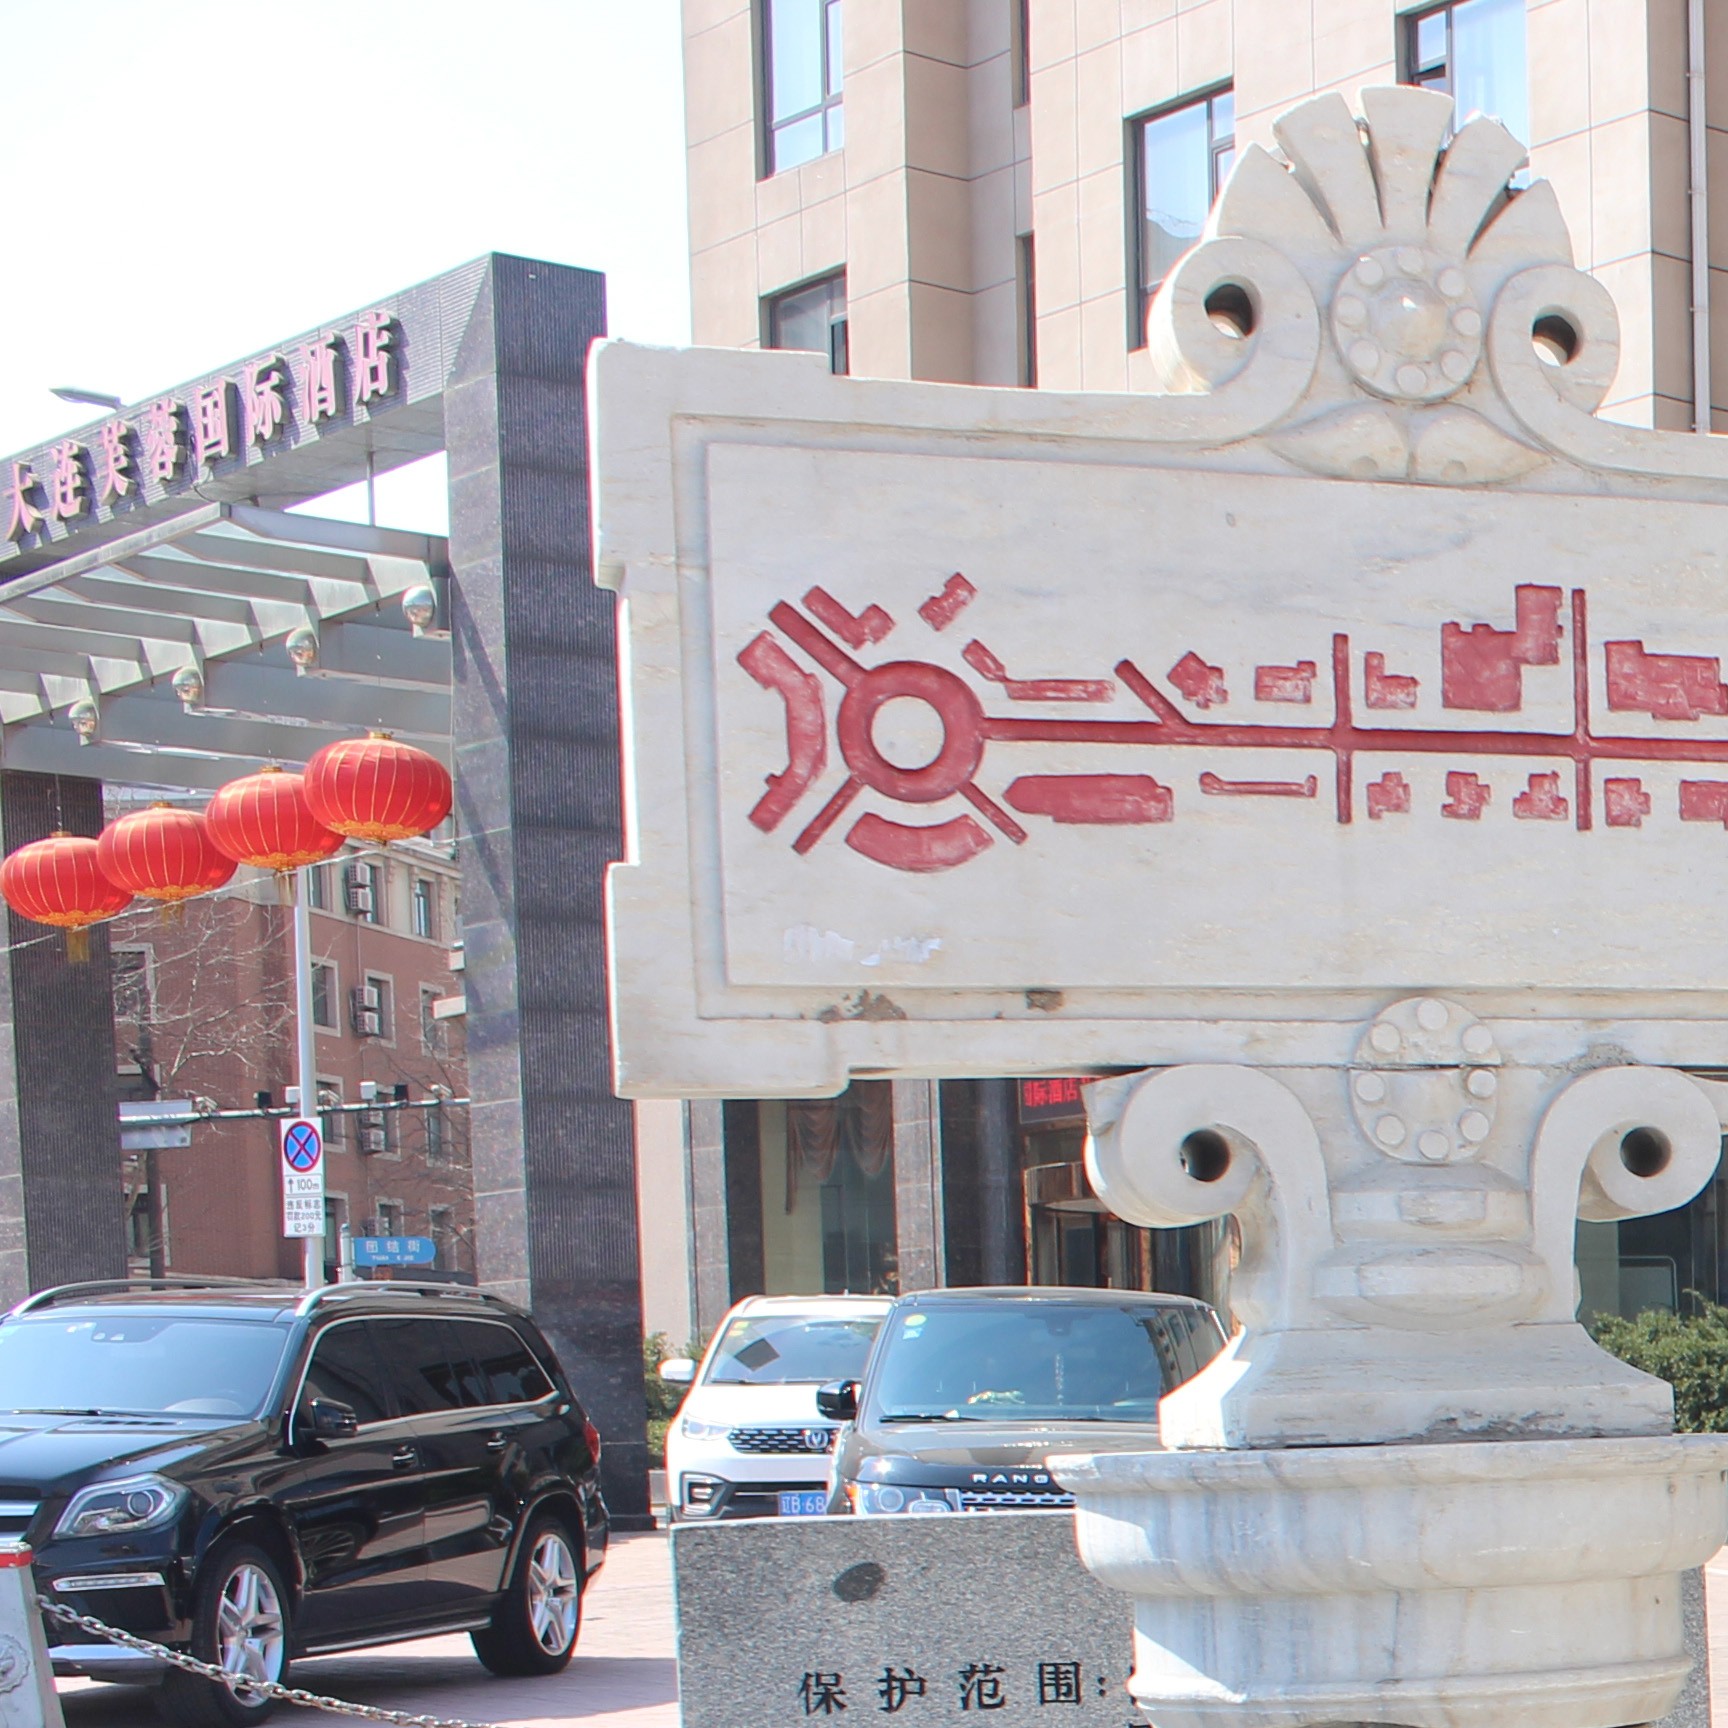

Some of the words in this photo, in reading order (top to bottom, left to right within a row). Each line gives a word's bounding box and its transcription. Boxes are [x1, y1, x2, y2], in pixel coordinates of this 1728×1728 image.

[6, 310, 401, 542] 大连芙蓉国际酒店
[799, 1661, 1137, 1717] 保护范围：
